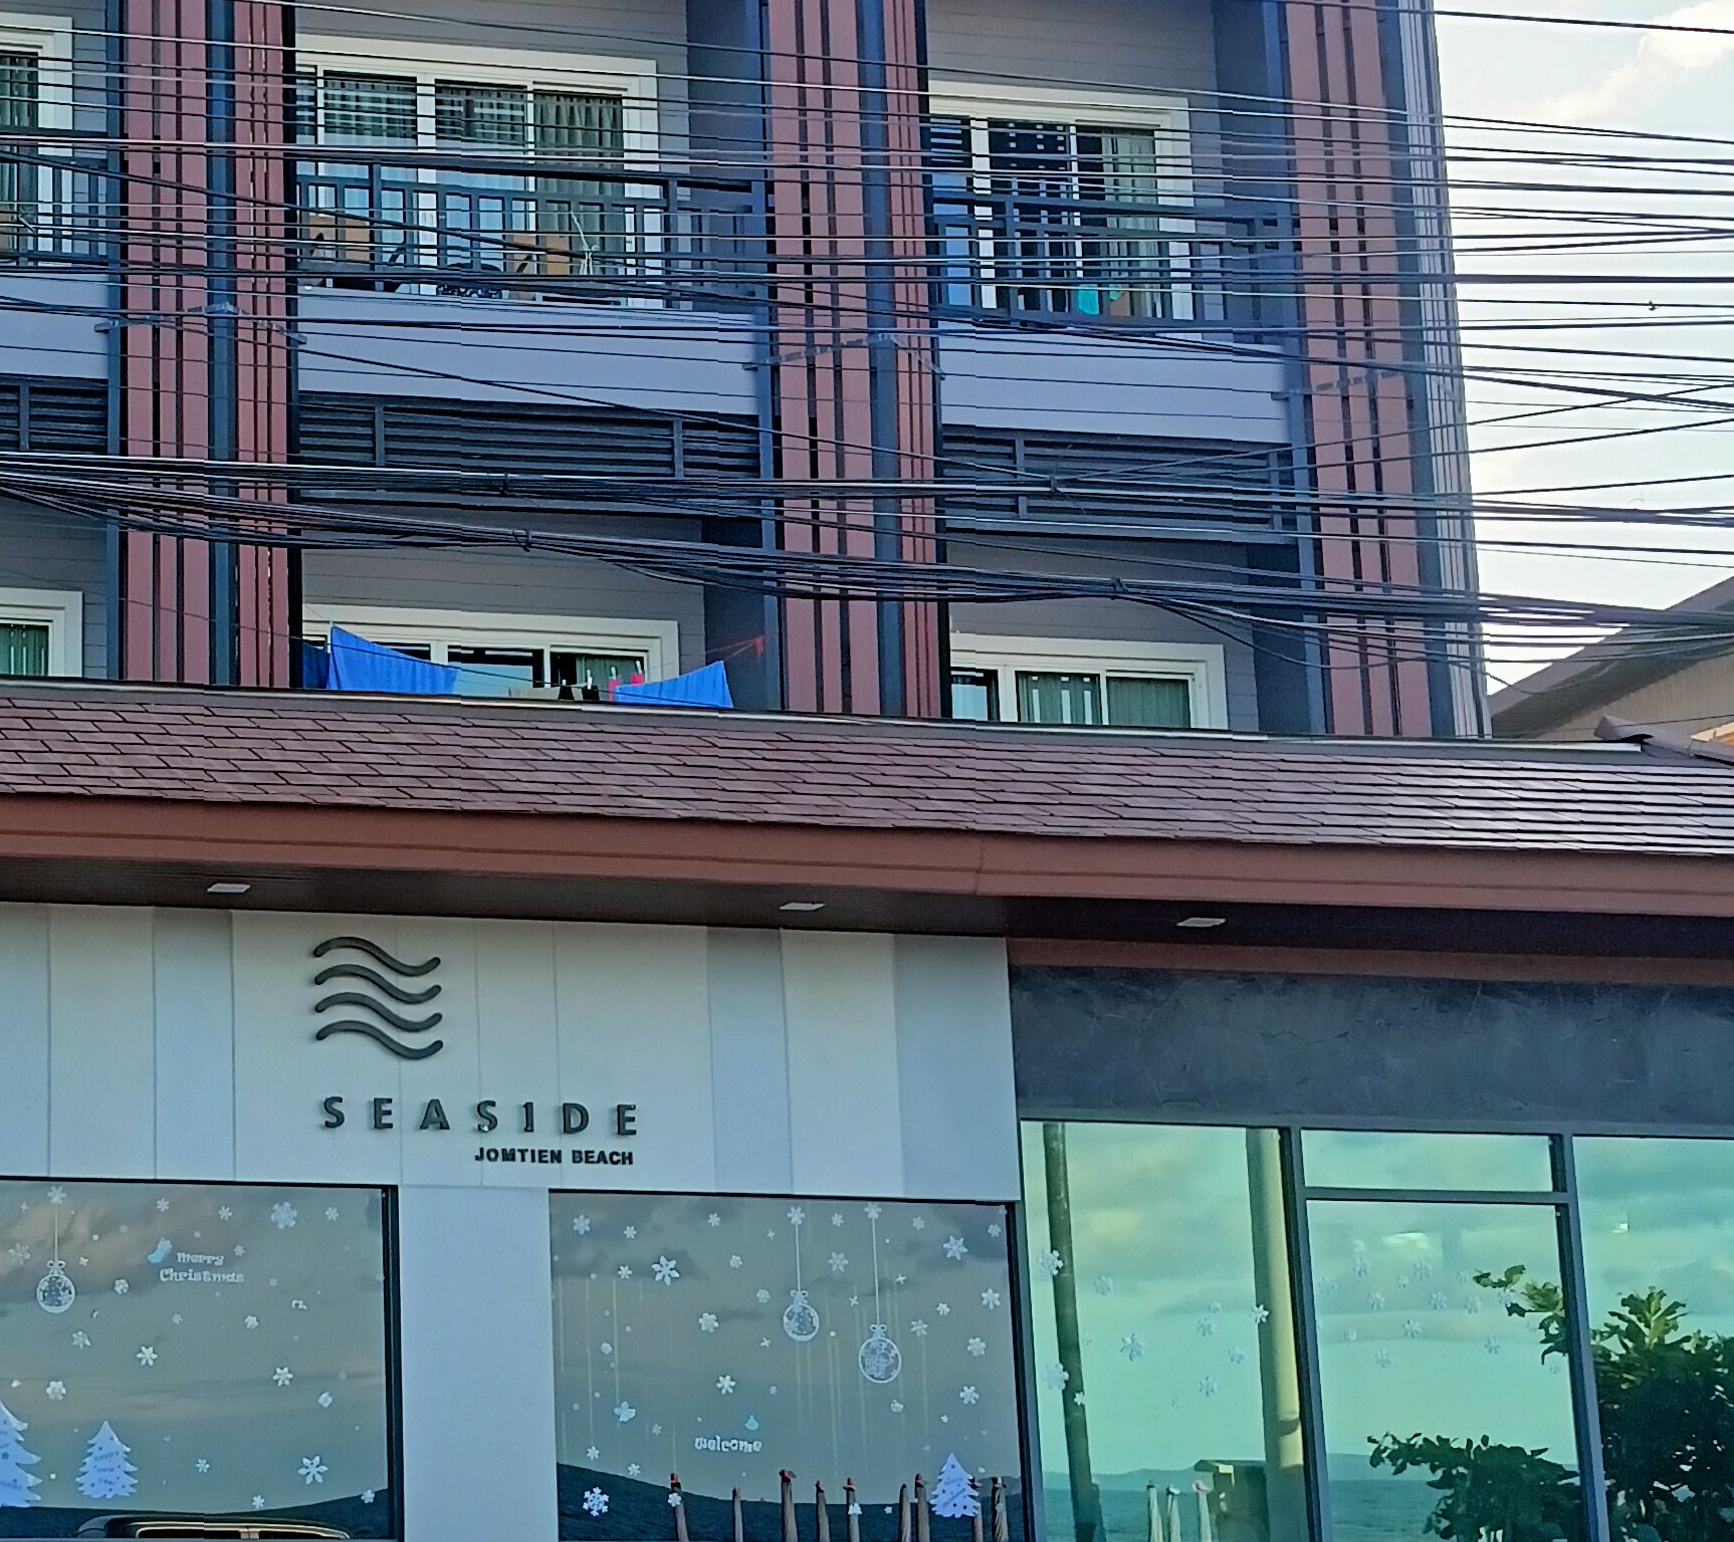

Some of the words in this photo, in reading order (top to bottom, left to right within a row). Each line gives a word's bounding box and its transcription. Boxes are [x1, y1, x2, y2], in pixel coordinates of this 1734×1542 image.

[323, 1096, 637, 1136] SEASIDE
[474, 1147, 562, 1164] JOMTIEN
[571, 1150, 634, 1166] BEACH
[159, 1267, 244, 1283] Christmas
